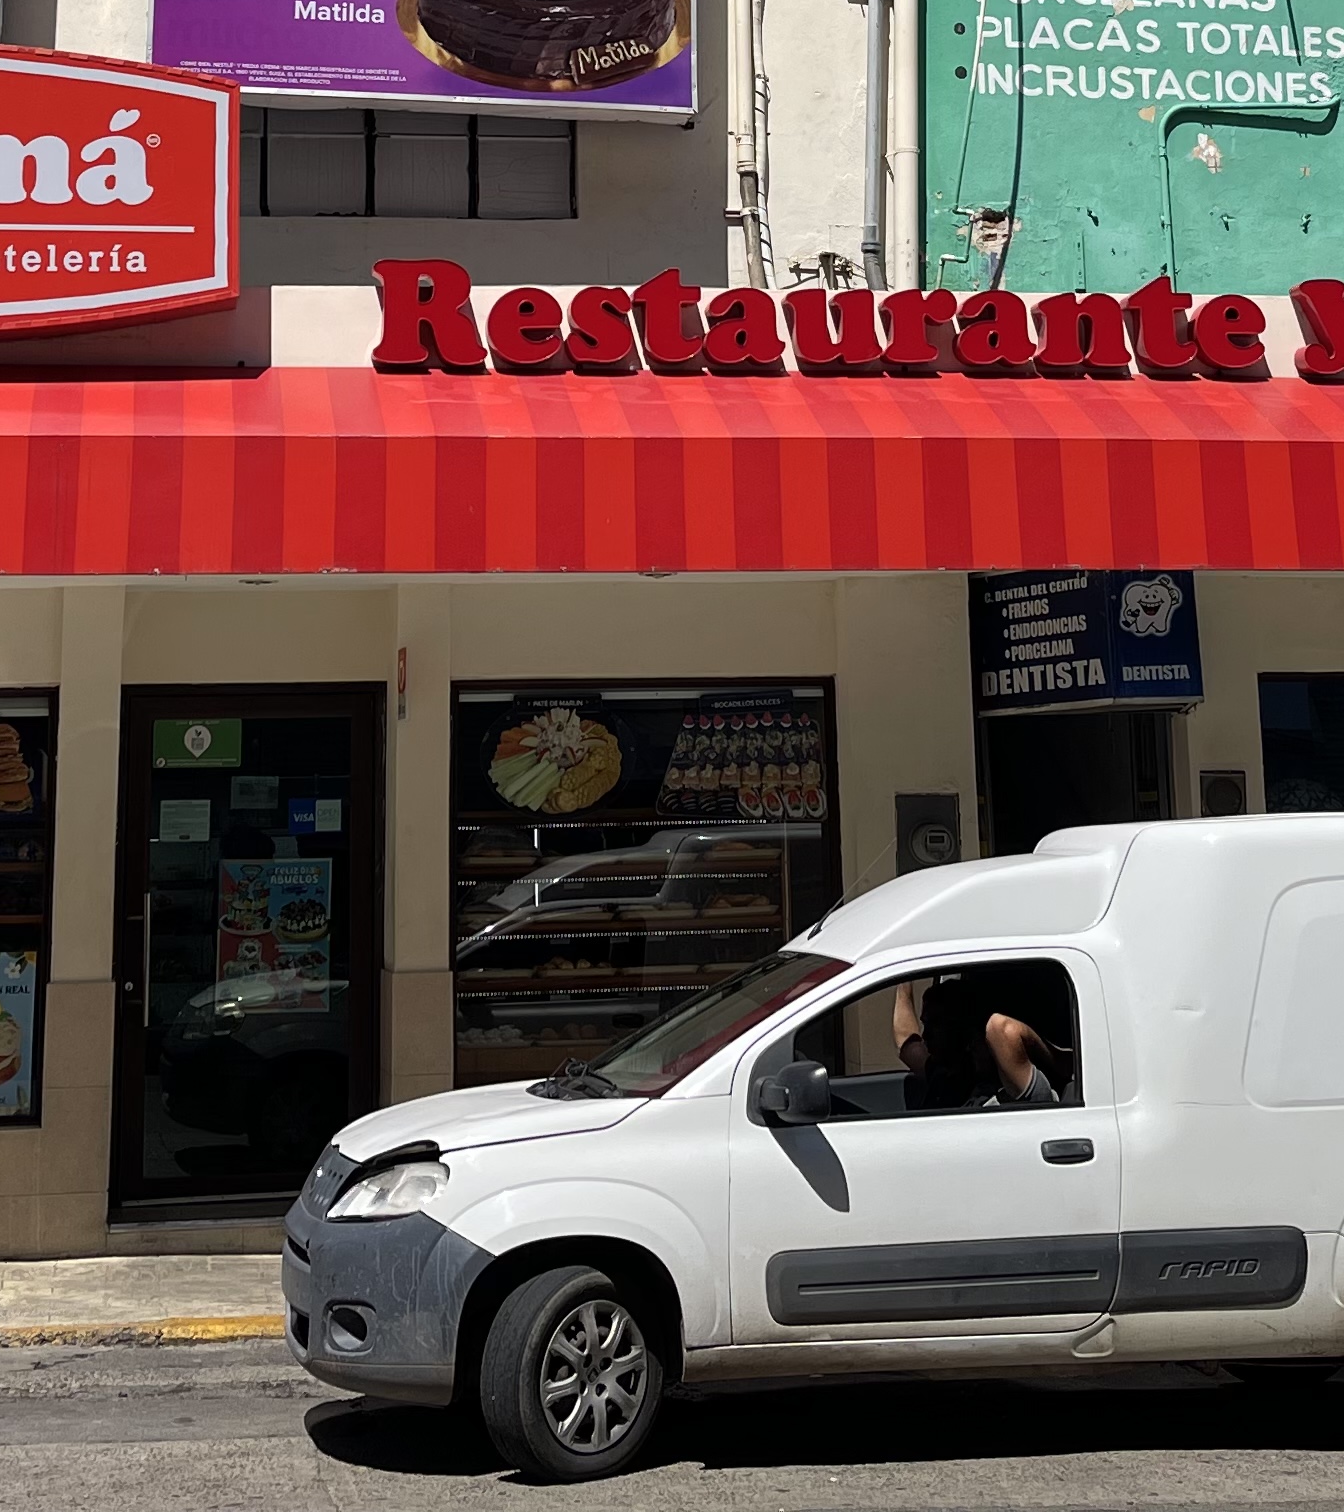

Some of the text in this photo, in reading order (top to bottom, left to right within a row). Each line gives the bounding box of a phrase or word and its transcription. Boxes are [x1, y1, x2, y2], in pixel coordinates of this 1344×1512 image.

[294, 0, 385, 25] Matilda
[976, 15, 1161, 53] PLACAS
[576, 39, 652, 77] Matilda
[976, 62, 1332, 103] INCRUSTACIONES
[372, 258, 1267, 369] Restaurante
[995, 586, 1029, 602] DENTAL
[1031, 584, 1047, 597] DEL
[1049, 576, 1087, 594] CENTRO
[1008, 599, 1049, 620] FRENOS
[1010, 615, 1087, 640] ENDODONCIAS
[1011, 639, 1074, 661] PORCELANA
[982, 658, 1105, 696] DENTISTA
[1123, 665, 1190, 681] DENTISTA
[293, 813, 315, 823] VISA
[270, 874, 320, 884] ABUELOS
[5, 985, 30, 994] REAL
[1159, 1257, 1260, 1280] RAPID
